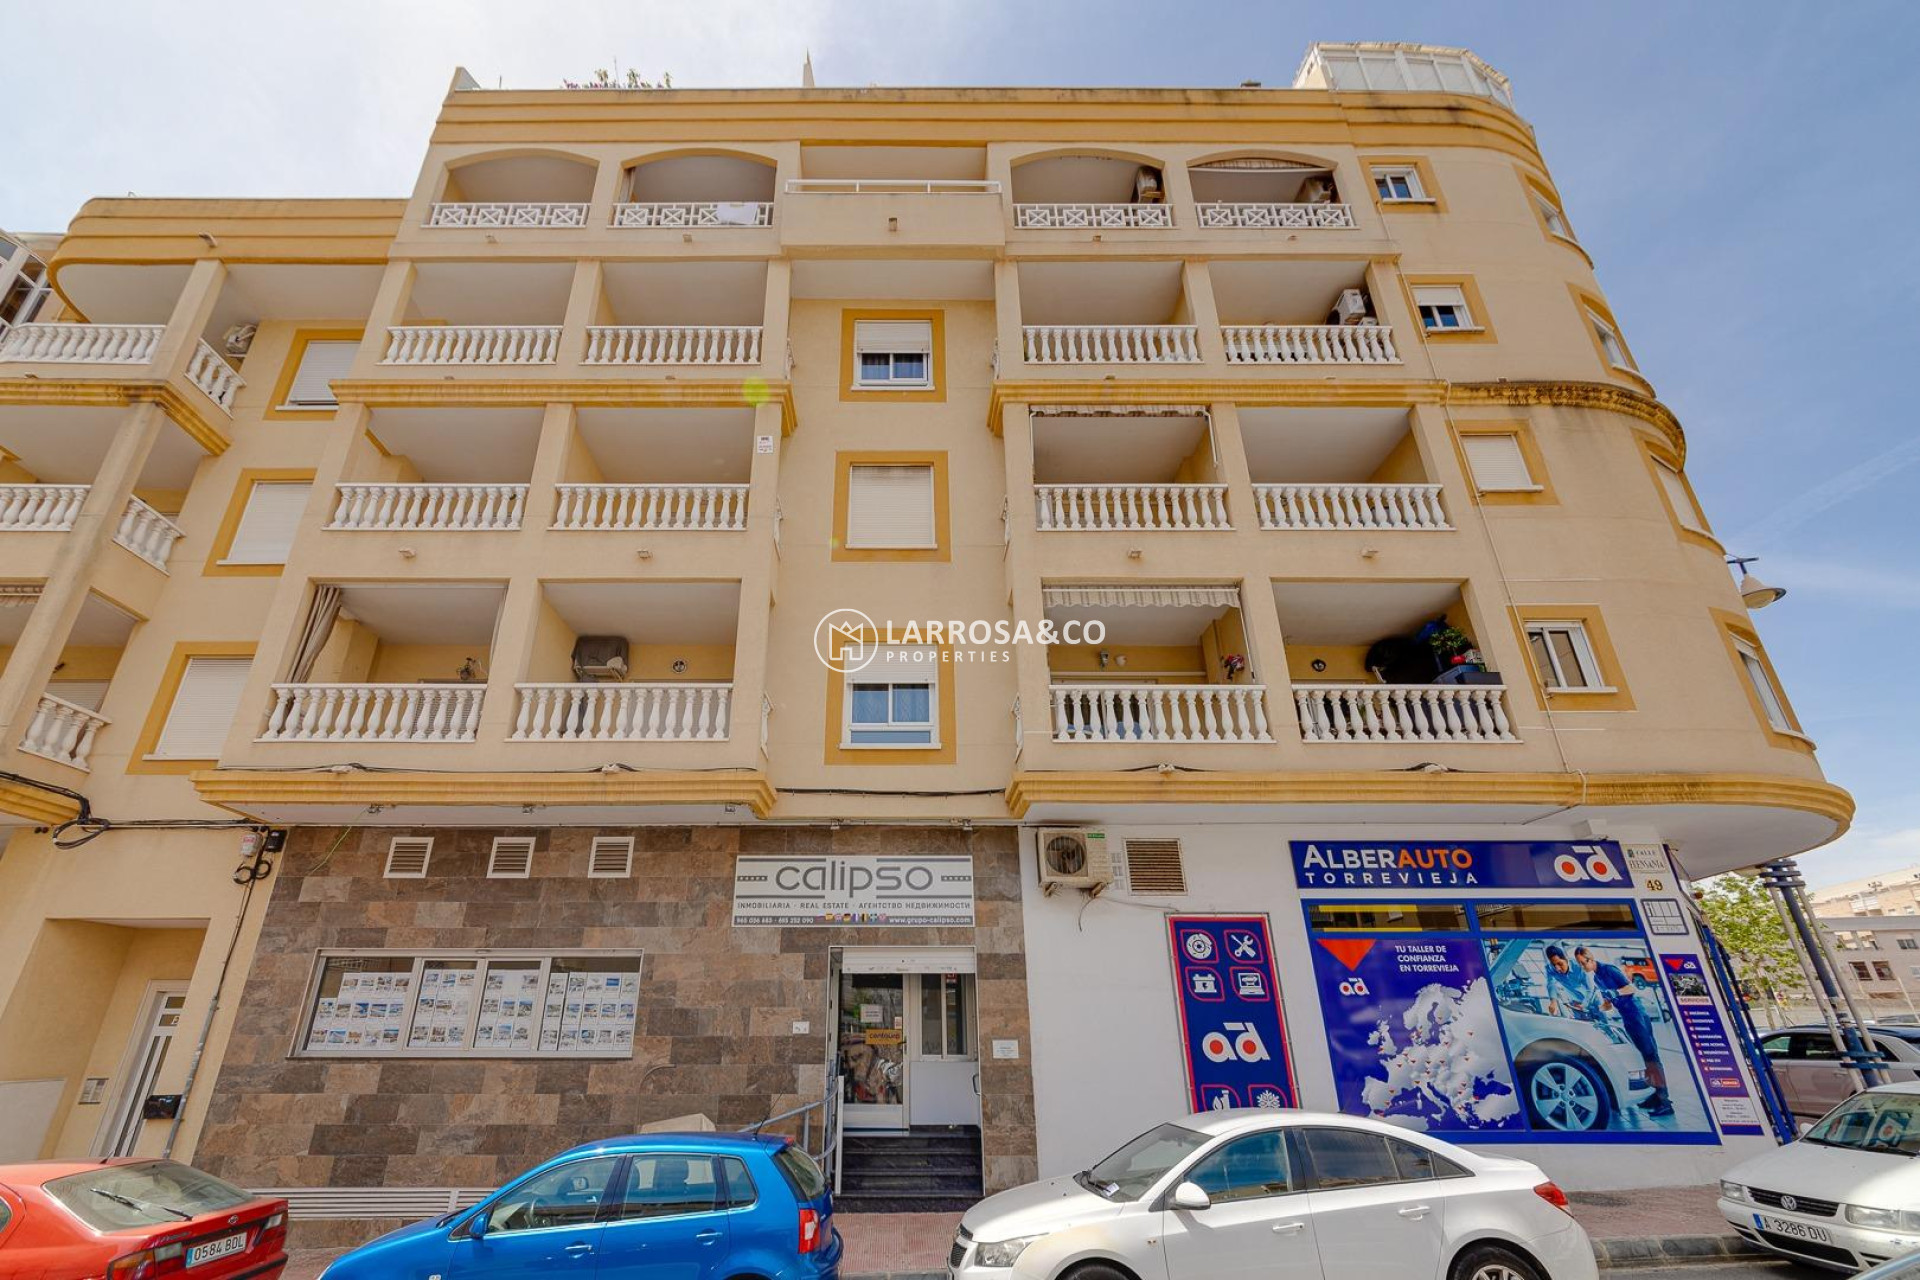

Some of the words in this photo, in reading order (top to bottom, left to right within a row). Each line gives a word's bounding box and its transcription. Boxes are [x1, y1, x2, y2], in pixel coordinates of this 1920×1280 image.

[1303, 844, 1473, 869] ALBERAUTO
[775, 860, 933, 898] calipso
[1305, 872, 1478, 884] TORREVIEJA
[1646, 879, 1664, 891] 49
[737, 901, 791, 909] INMOBILIARIA
[800, 901, 819, 909] REAL
[822, 901, 849, 909] ESTATE
[858, 901, 903, 909] АГЕНТСТВО
[1395, 945, 1406, 953] TU
[1407, 945, 1435, 953] TALLER
[1436, 945, 1447, 953] DE
[1397, 954, 1447, 963] CONFIANZA
[1400, 964, 1412, 973] EN
[1413, 964, 1460, 973] TORREVIEJA
[1774, 1219, 1806, 1237] 3286
[1808, 1226, 1827, 1241] DU
[194, 1241, 222, 1261] 0584
[224, 1236, 243, 1251] BDL
